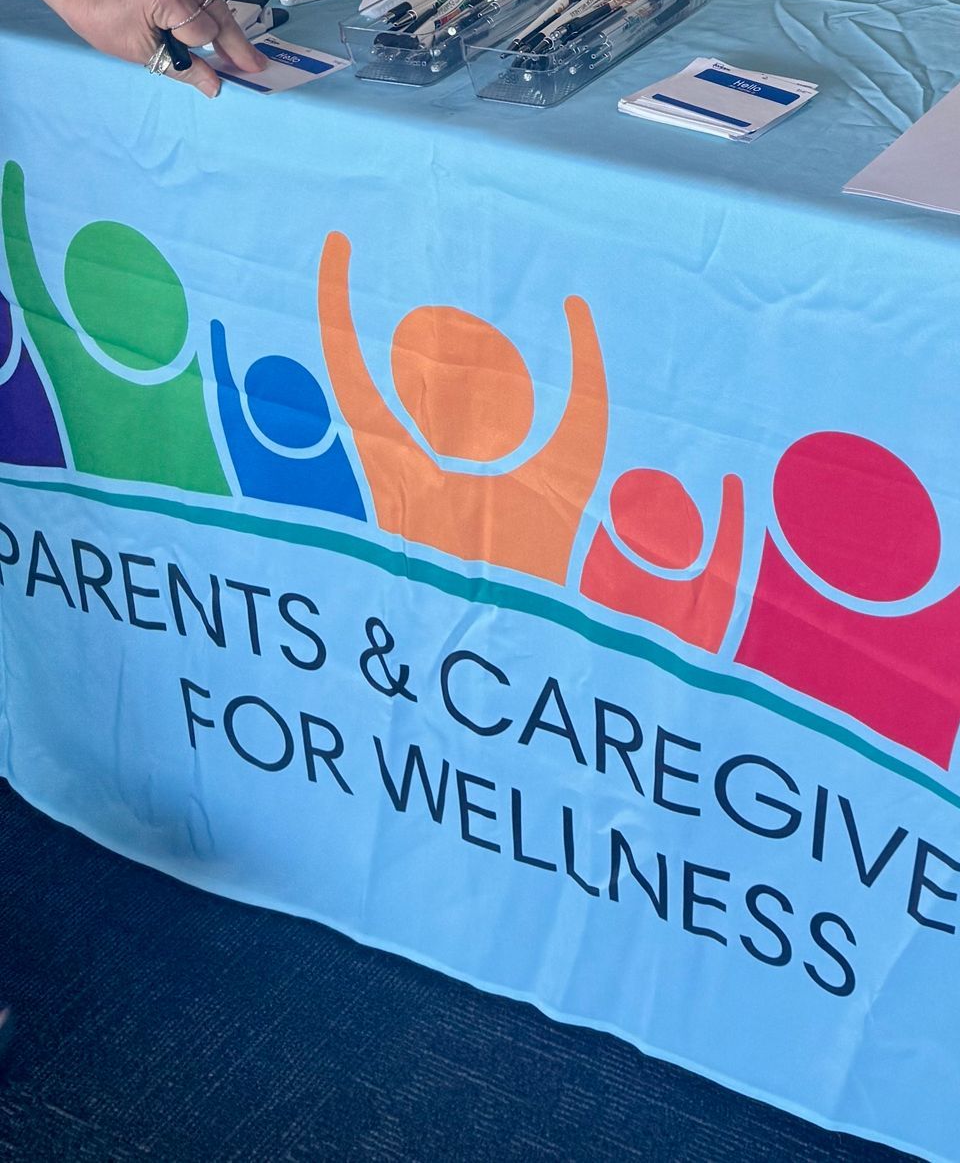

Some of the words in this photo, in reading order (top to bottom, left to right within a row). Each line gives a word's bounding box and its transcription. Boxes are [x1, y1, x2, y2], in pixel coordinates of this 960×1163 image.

[733, 79, 762, 92] Hello
[0, 523, 327, 671] PARENTS
[359, 616, 418, 703] &
[179, 677, 355, 796] FOR
[372, 735, 858, 998] WELLNESS
